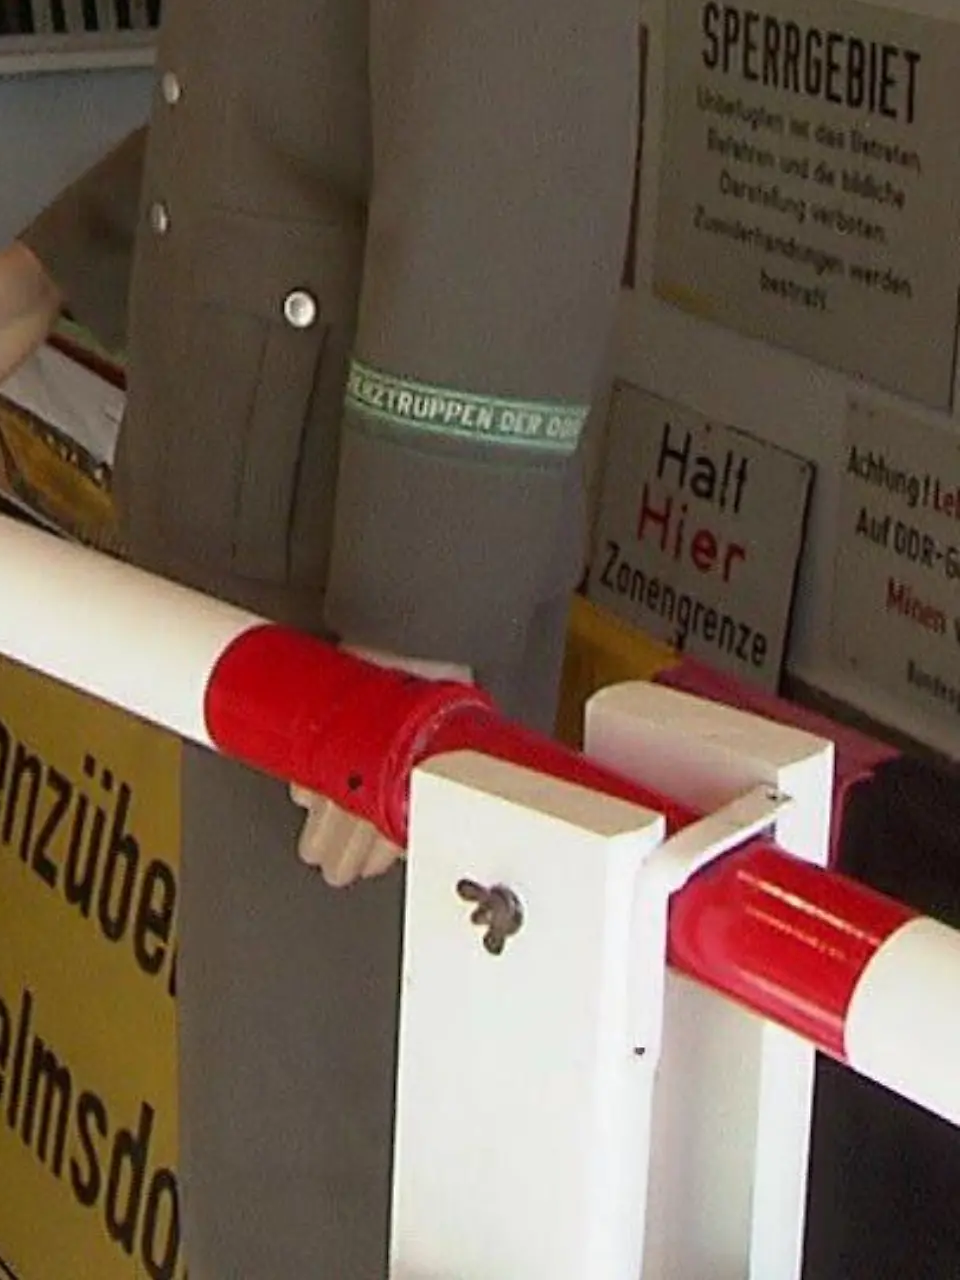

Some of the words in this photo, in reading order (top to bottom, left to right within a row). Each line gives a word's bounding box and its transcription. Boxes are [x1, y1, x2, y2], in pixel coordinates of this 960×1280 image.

[701, 0, 921, 124] SPERRGEBIET
[814, 124, 844, 148] das
[778, 156, 809, 179] und
[813, 161, 835, 185] die
[500, 407, 543, 435] DER
[657, 422, 748, 514] Halt
[932, 476, 960, 521] Le
[637, 483, 746, 583] Hier
[855, 507, 892, 549] Auf
[599, 540, 768, 668] Zonengrenze
[886, 576, 947, 635] Minen
